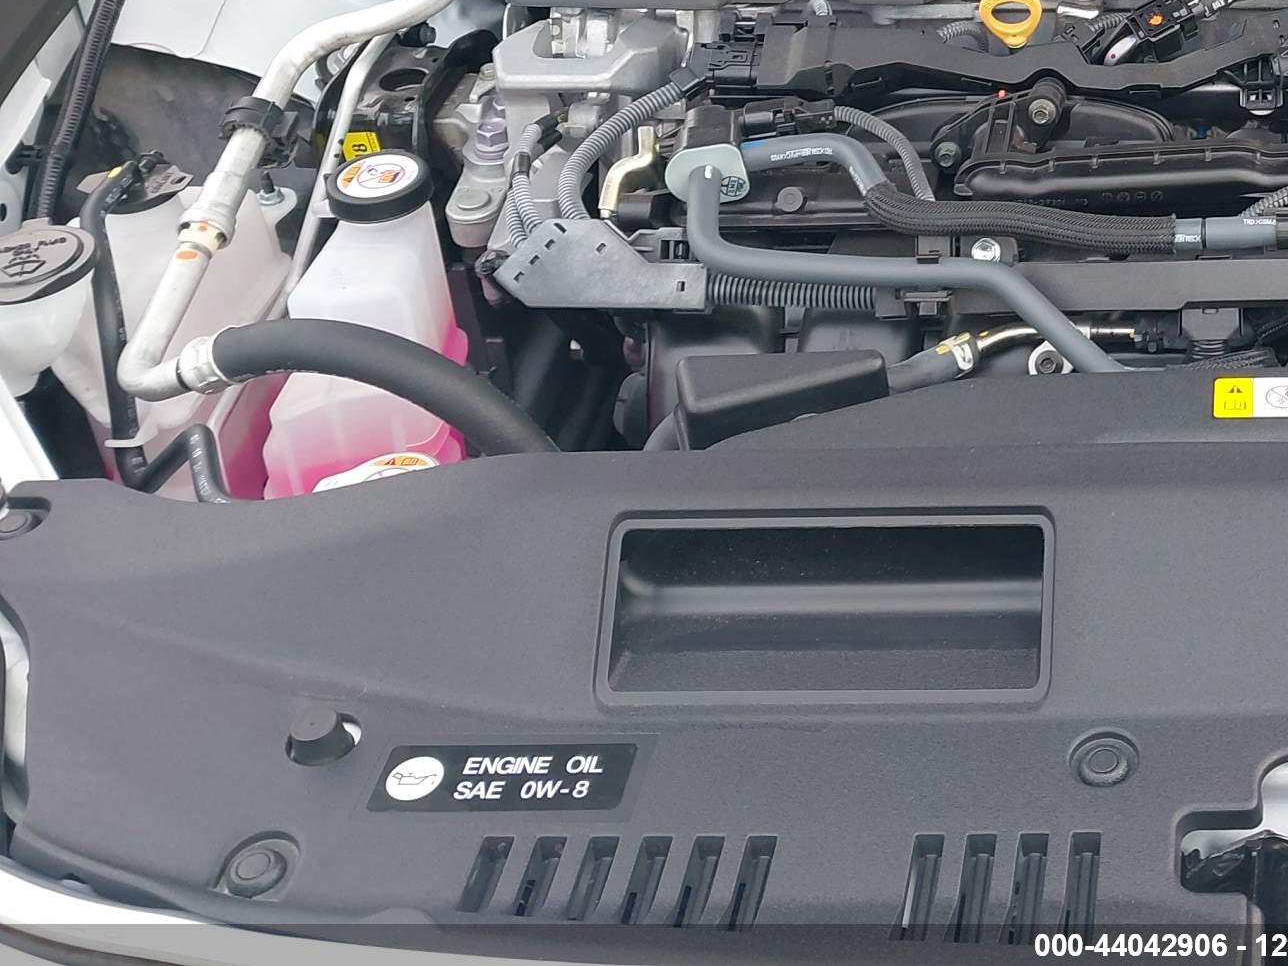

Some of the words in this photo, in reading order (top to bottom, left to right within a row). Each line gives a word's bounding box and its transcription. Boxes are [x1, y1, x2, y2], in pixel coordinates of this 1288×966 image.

[462, 756, 553, 775] ENGINE
[566, 755, 603, 773] OIL
[453, 780, 505, 799] SAE
[520, 780, 589, 799] 0W-8
